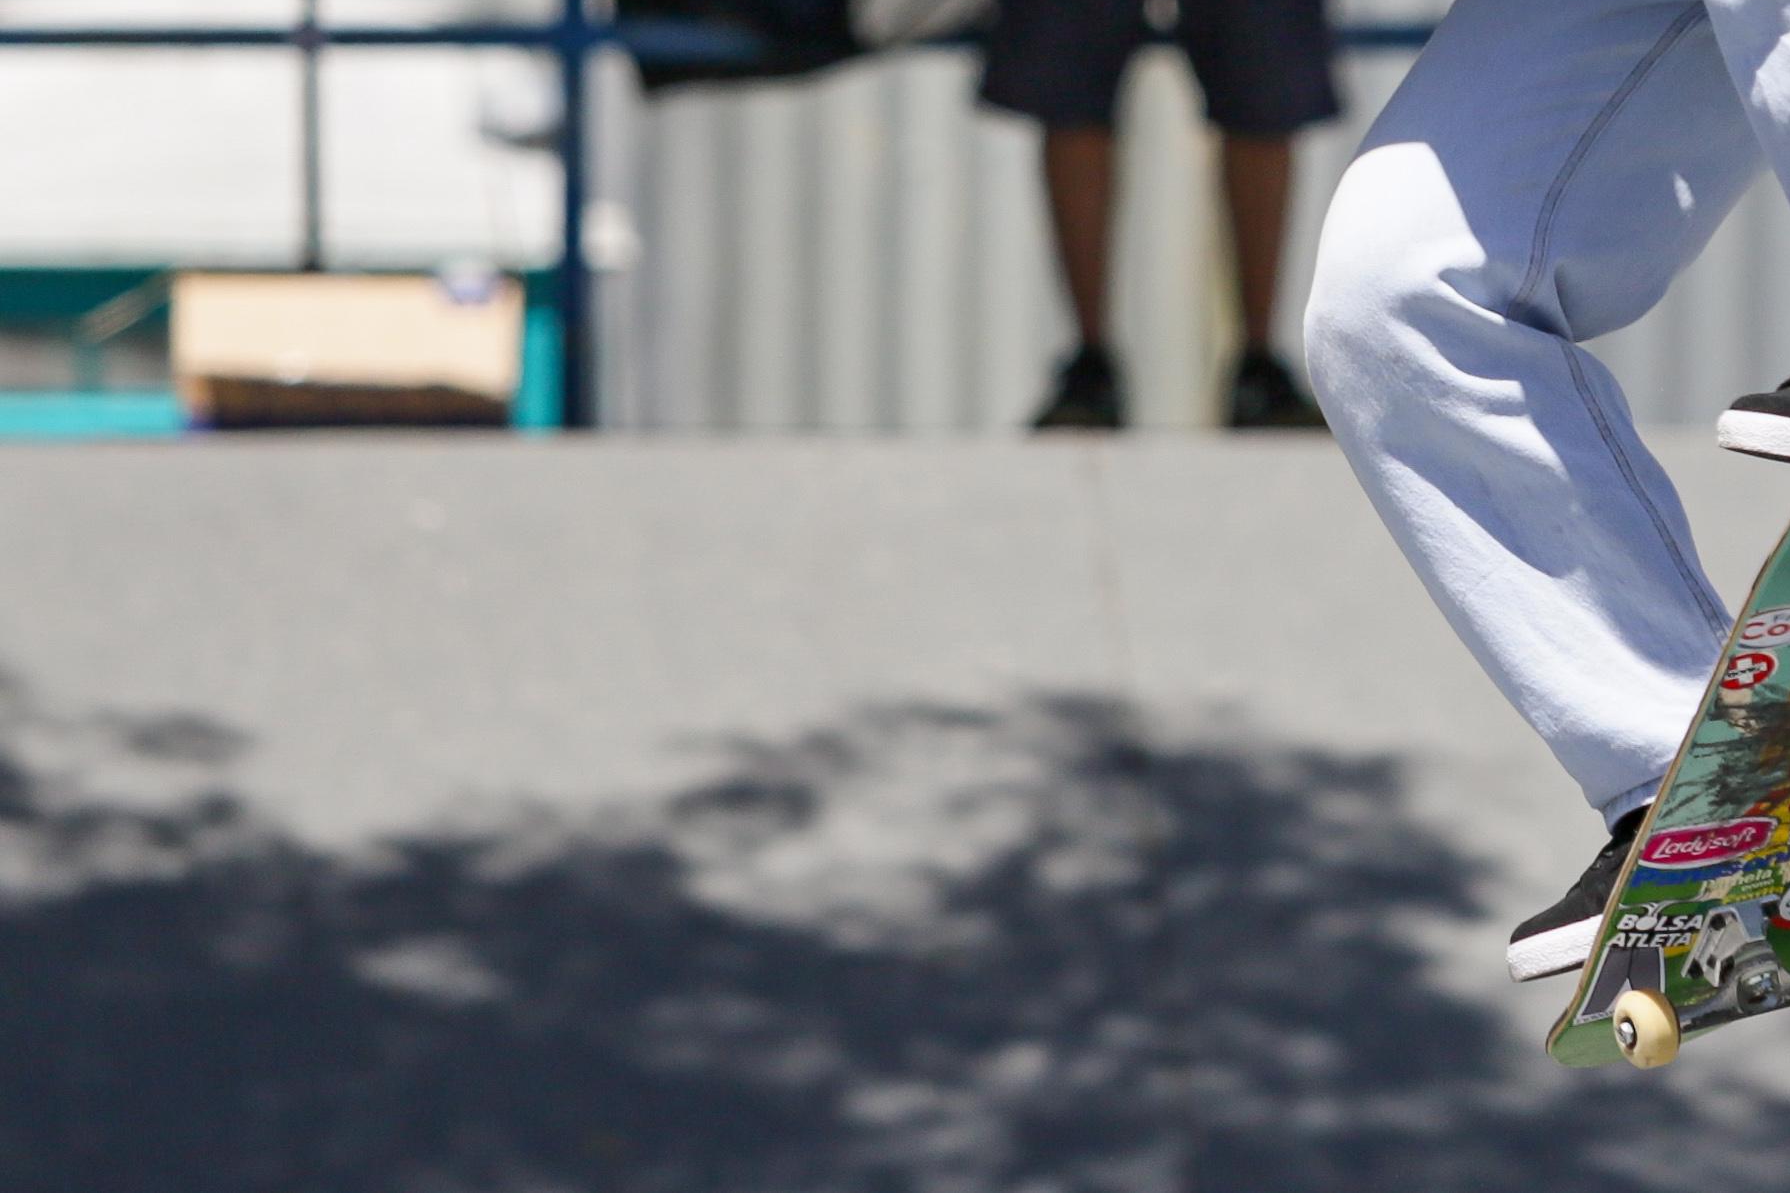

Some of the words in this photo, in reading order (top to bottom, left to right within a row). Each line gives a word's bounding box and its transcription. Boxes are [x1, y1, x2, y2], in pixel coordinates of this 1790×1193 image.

[1652, 826, 1757, 859] Ladysoft
[1616, 913, 1703, 932] BOLSA
[1606, 932, 1692, 948] ATLETA
